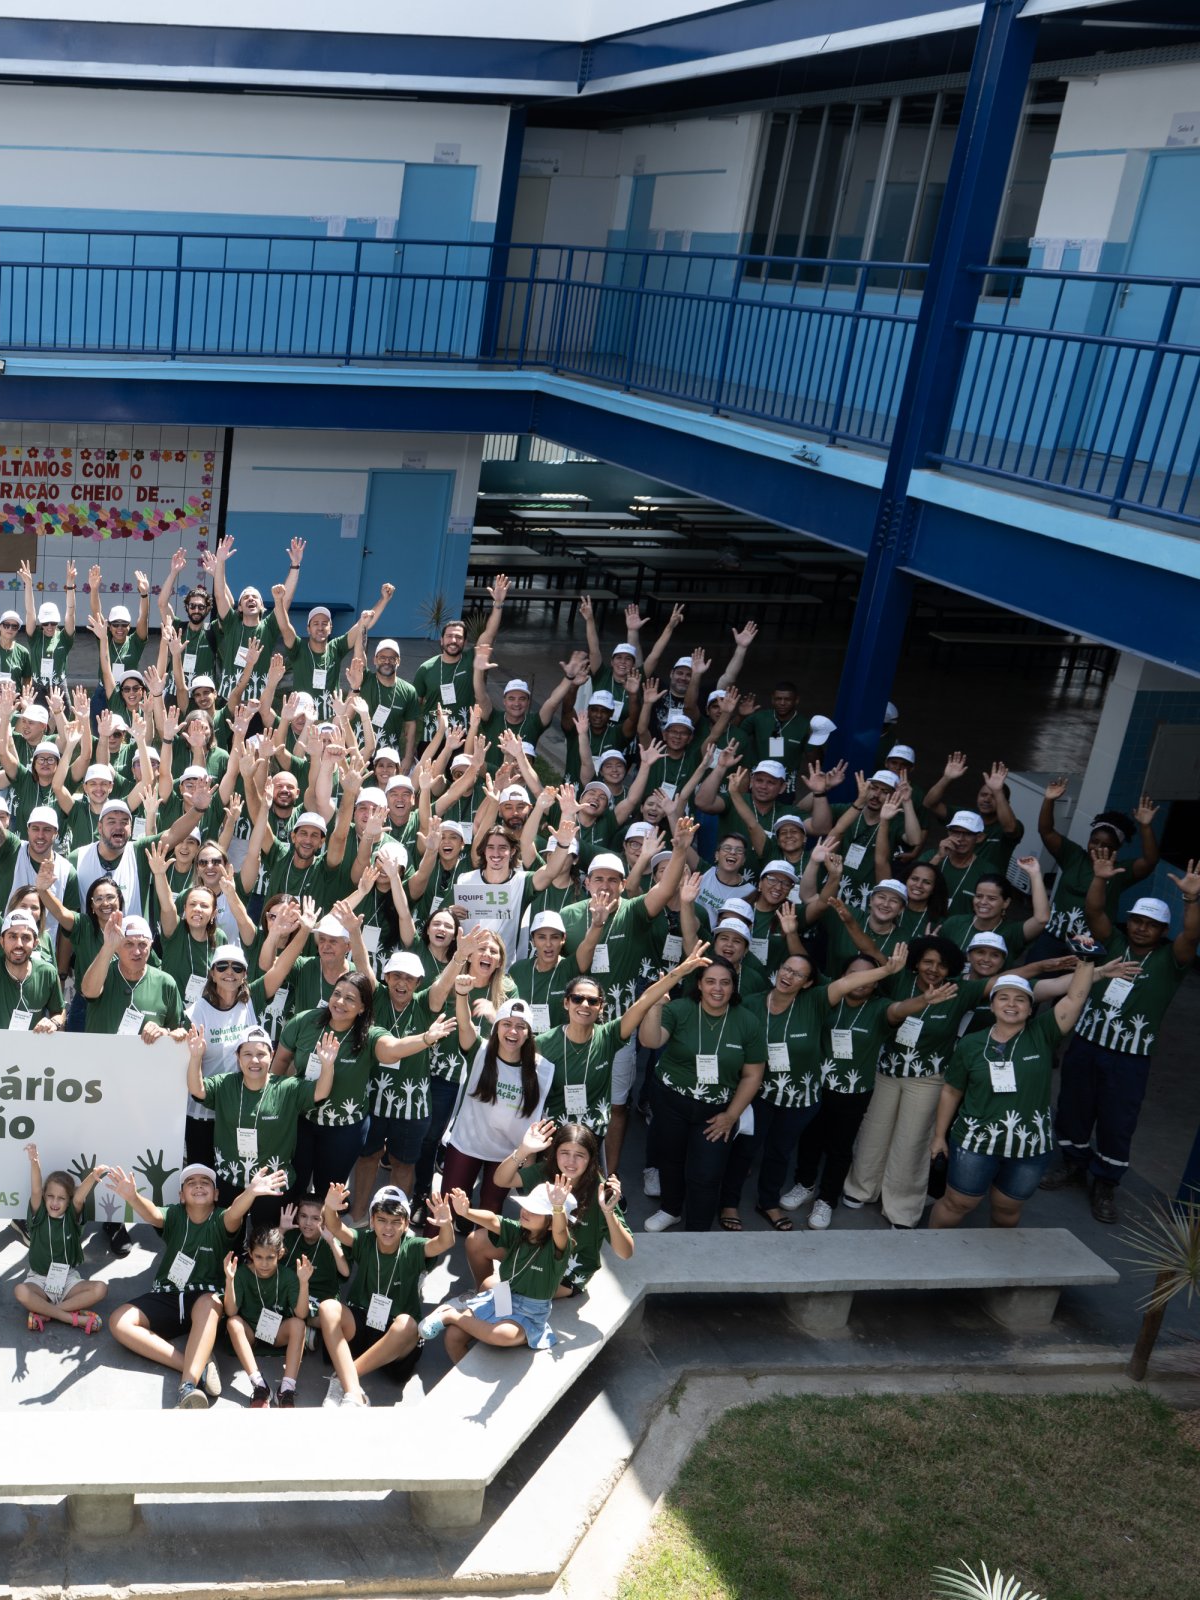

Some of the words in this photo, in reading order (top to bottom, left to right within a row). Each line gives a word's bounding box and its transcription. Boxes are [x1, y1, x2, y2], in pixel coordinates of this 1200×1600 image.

[82, 463, 120, 479] COM
[130, 464, 142, 480] O
[71, 484, 123, 501] CHEIO
[136, 486, 175, 503] DE...
[458, 894, 483, 902] EQUIPE
[485, 891, 509, 905] 13
